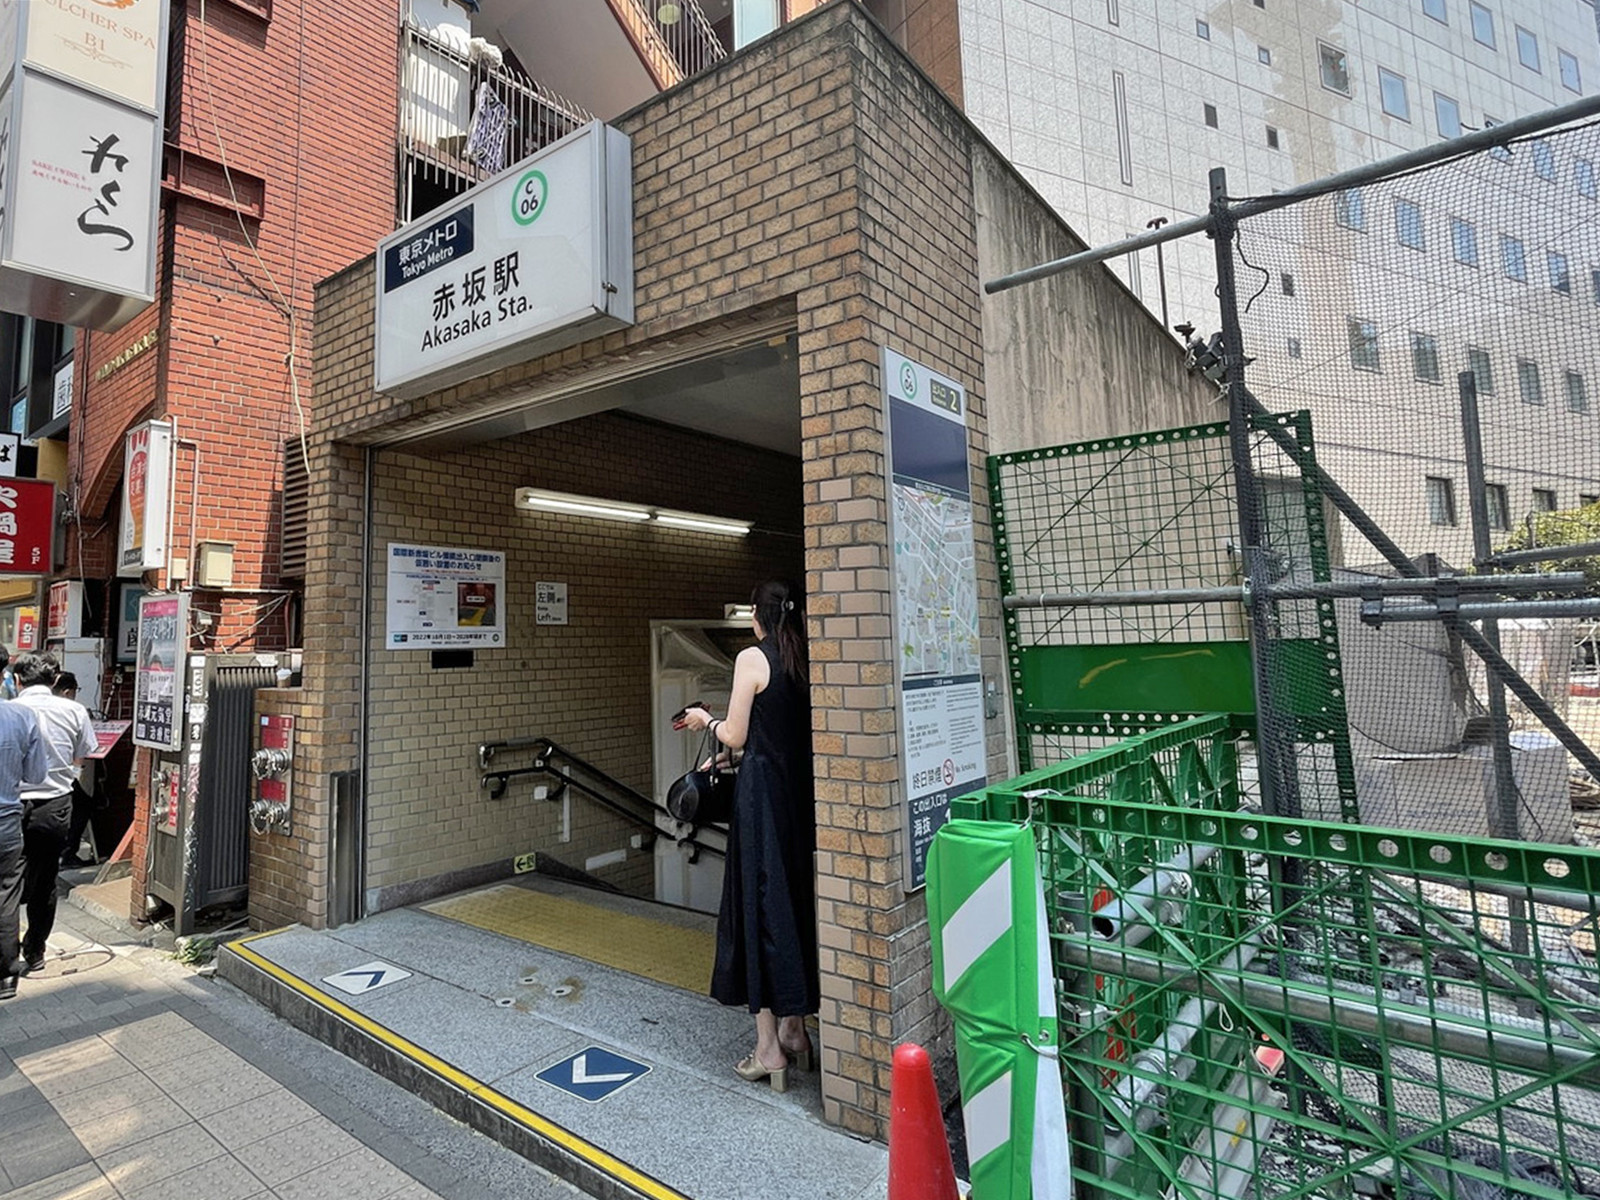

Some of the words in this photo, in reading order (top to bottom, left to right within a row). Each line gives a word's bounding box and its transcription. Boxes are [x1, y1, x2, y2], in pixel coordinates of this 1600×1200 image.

[84, 32, 105, 51] B1
[123, 26, 156, 50] SPA
[525, 180, 534, 196] C
[521, 196, 539, 215] 06
[398, 220, 458, 266] 東京メトロ
[401, 255, 426, 279] Tokyo
[427, 245, 454, 268] Metro
[433, 251, 520, 322] 赤坂駅
[420, 309, 492, 352] Akasaka
[498, 295, 534, 322] Sta.
[950, 390, 958, 411] 2
